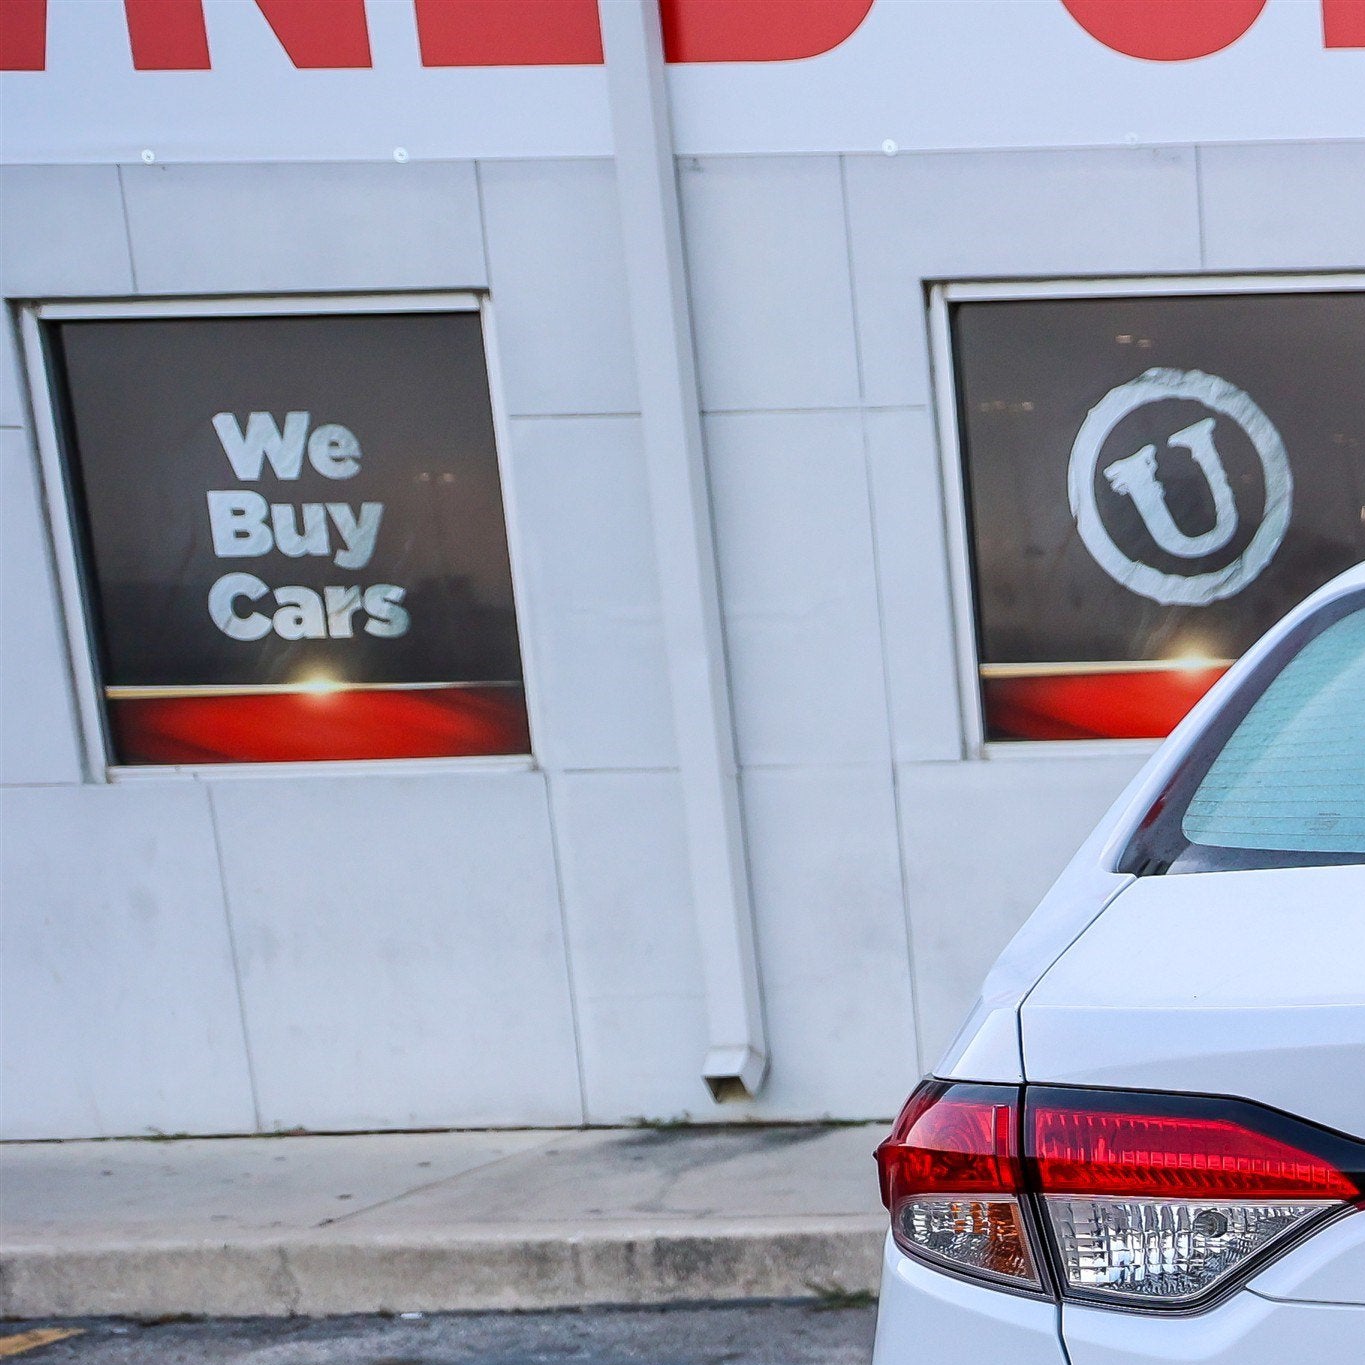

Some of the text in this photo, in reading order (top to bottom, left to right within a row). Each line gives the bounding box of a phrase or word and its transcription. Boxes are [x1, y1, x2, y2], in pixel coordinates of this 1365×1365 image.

[211, 411, 363, 481] We
[1103, 417, 1239, 558] U
[206, 490, 385, 570] Buy
[208, 572, 411, 641] Cars
